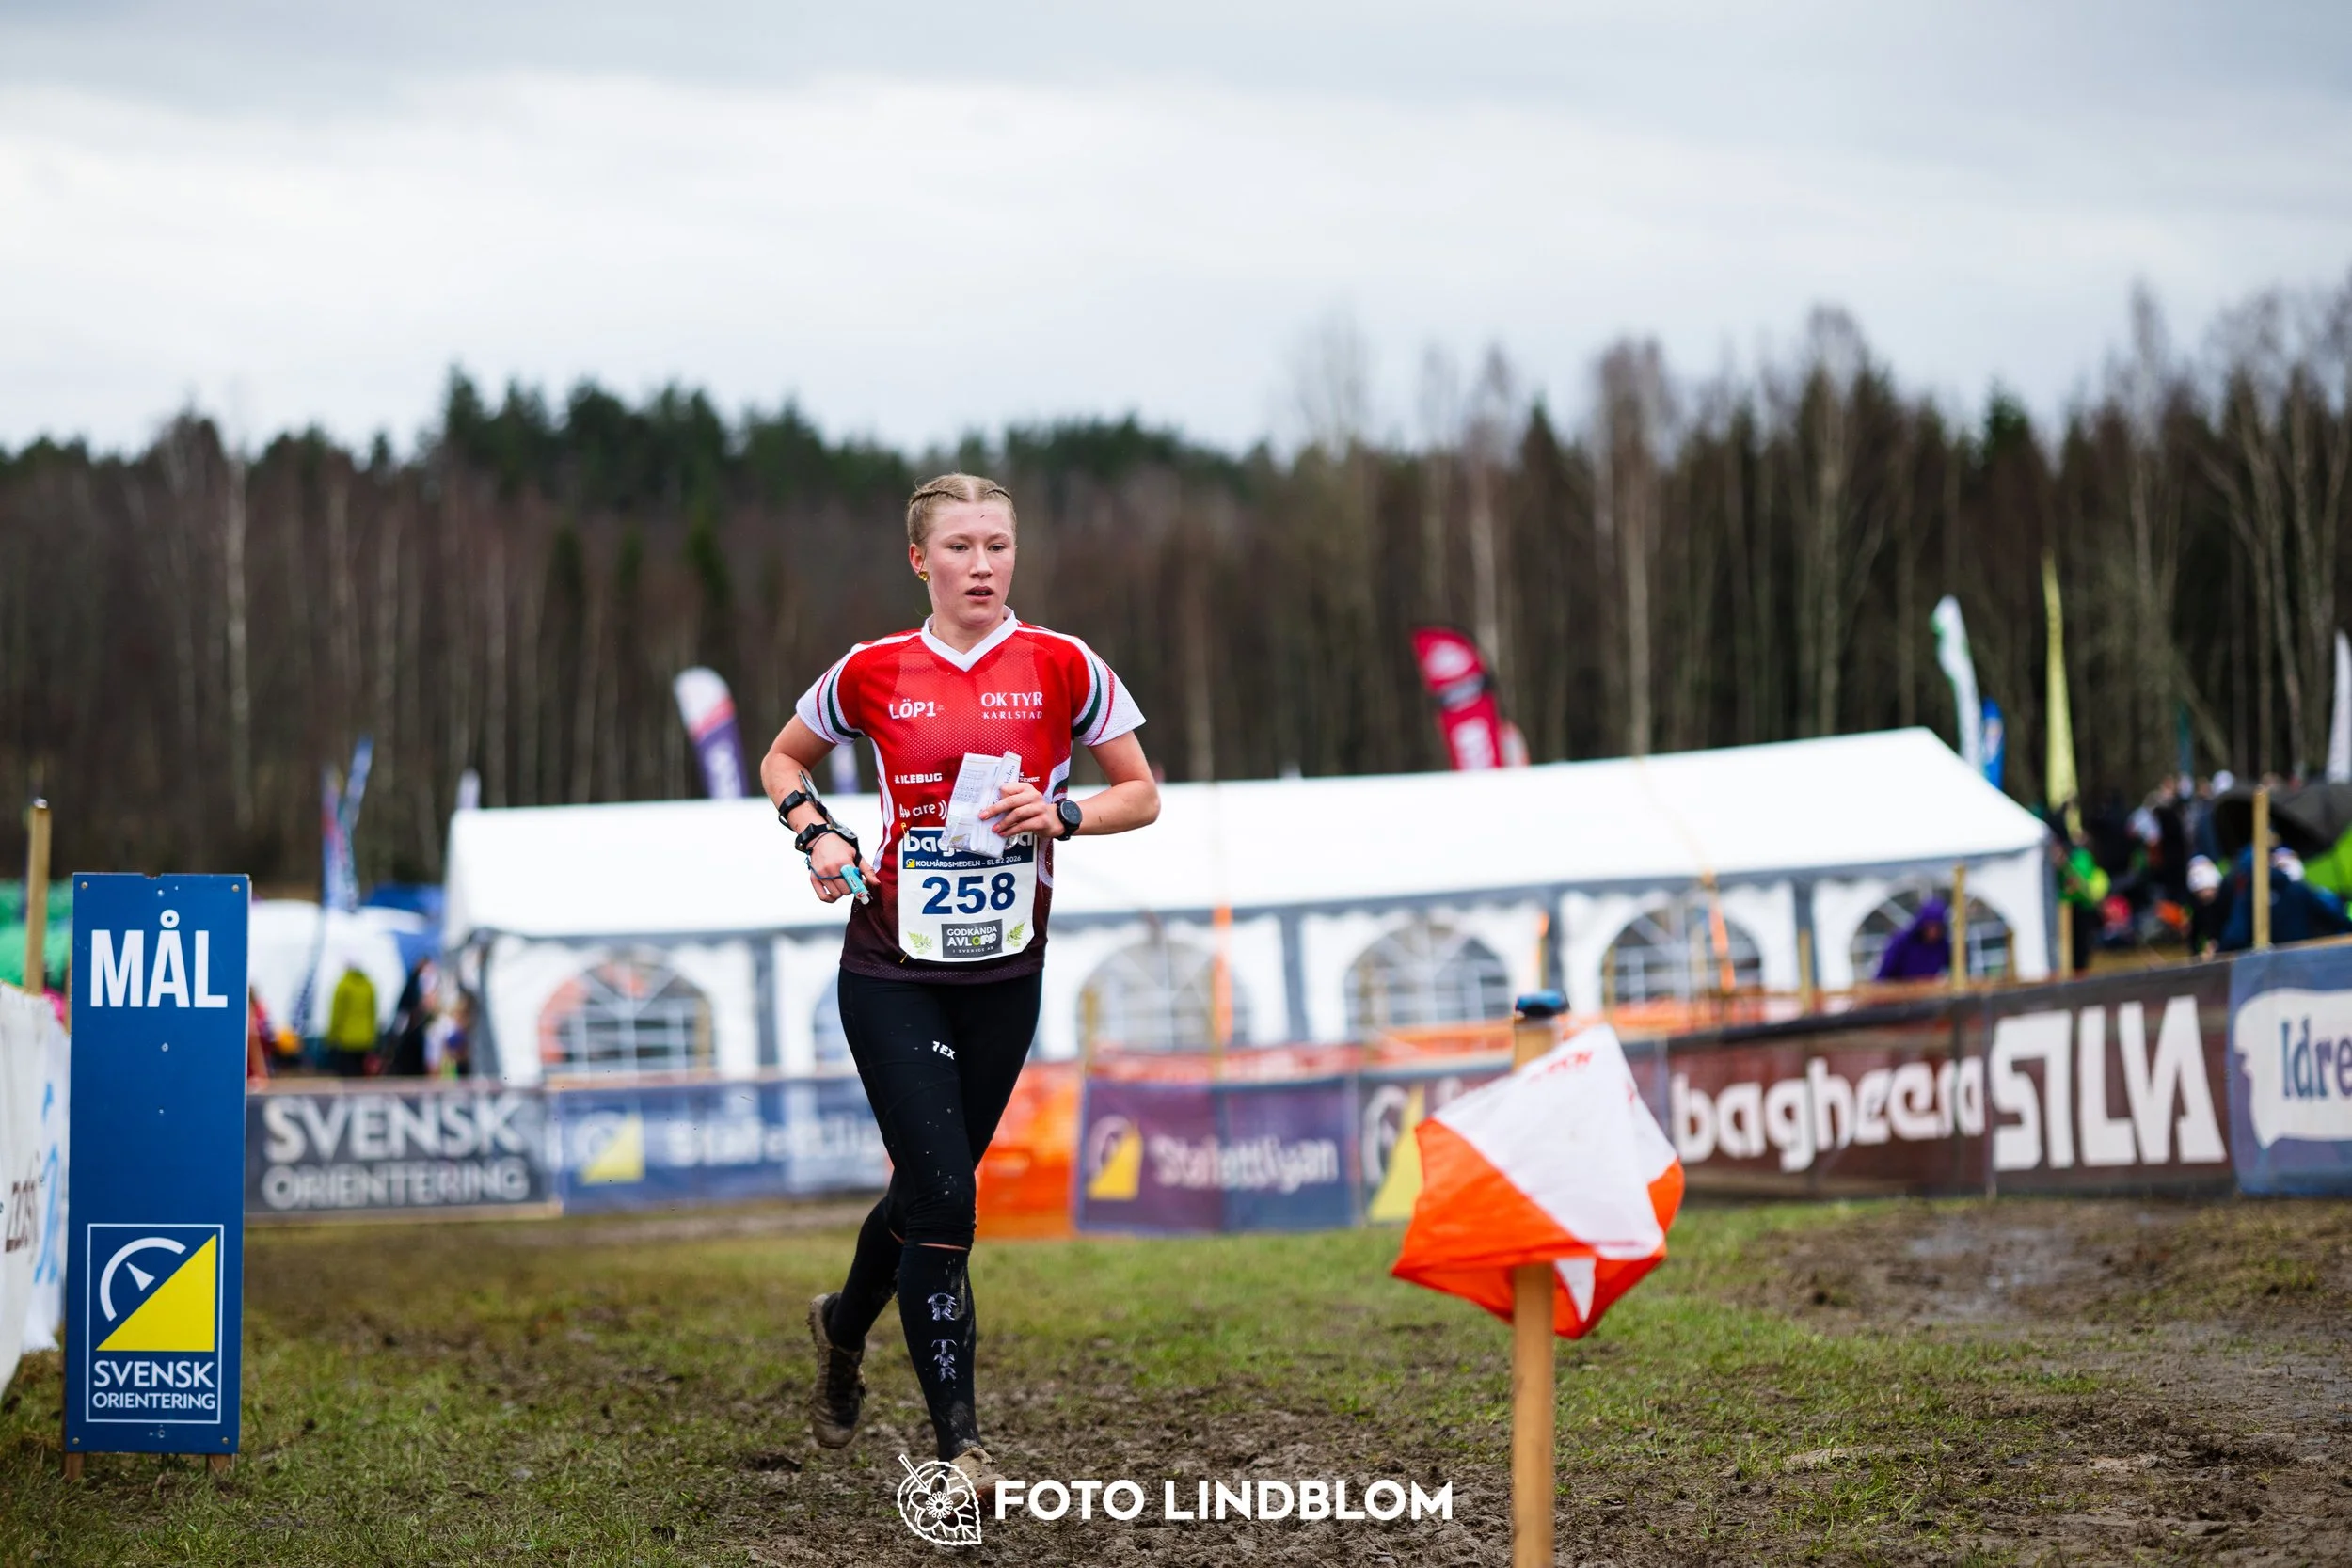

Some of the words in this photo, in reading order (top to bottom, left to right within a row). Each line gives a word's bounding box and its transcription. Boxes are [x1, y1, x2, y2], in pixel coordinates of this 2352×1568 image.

[889, 698, 936, 720] LÖP1
[980, 692, 1008, 707] OK
[1010, 691, 1043, 706] TYR
[983, 710, 1043, 720] KARLSTAD
[915, 858, 981, 868] KOLMÅRDSMEDELN
[1005, 855, 1022, 863] 2026
[922, 872, 1016, 914] 258
[946, 926, 998, 937] GODKÄNDA
[946, 934, 997, 947] AVLOPP
[90, 909, 228, 1008] MÅL
[1992, 994, 2227, 1172] SILVA
[1671, 1056, 1984, 1173] bagheera
[263, 1091, 524, 1164] SVENSK
[262, 1157, 530, 1211] ORIENTERING
[94, 1360, 215, 1388] SVENSK
[92, 1391, 215, 1410] ORIENTERING
